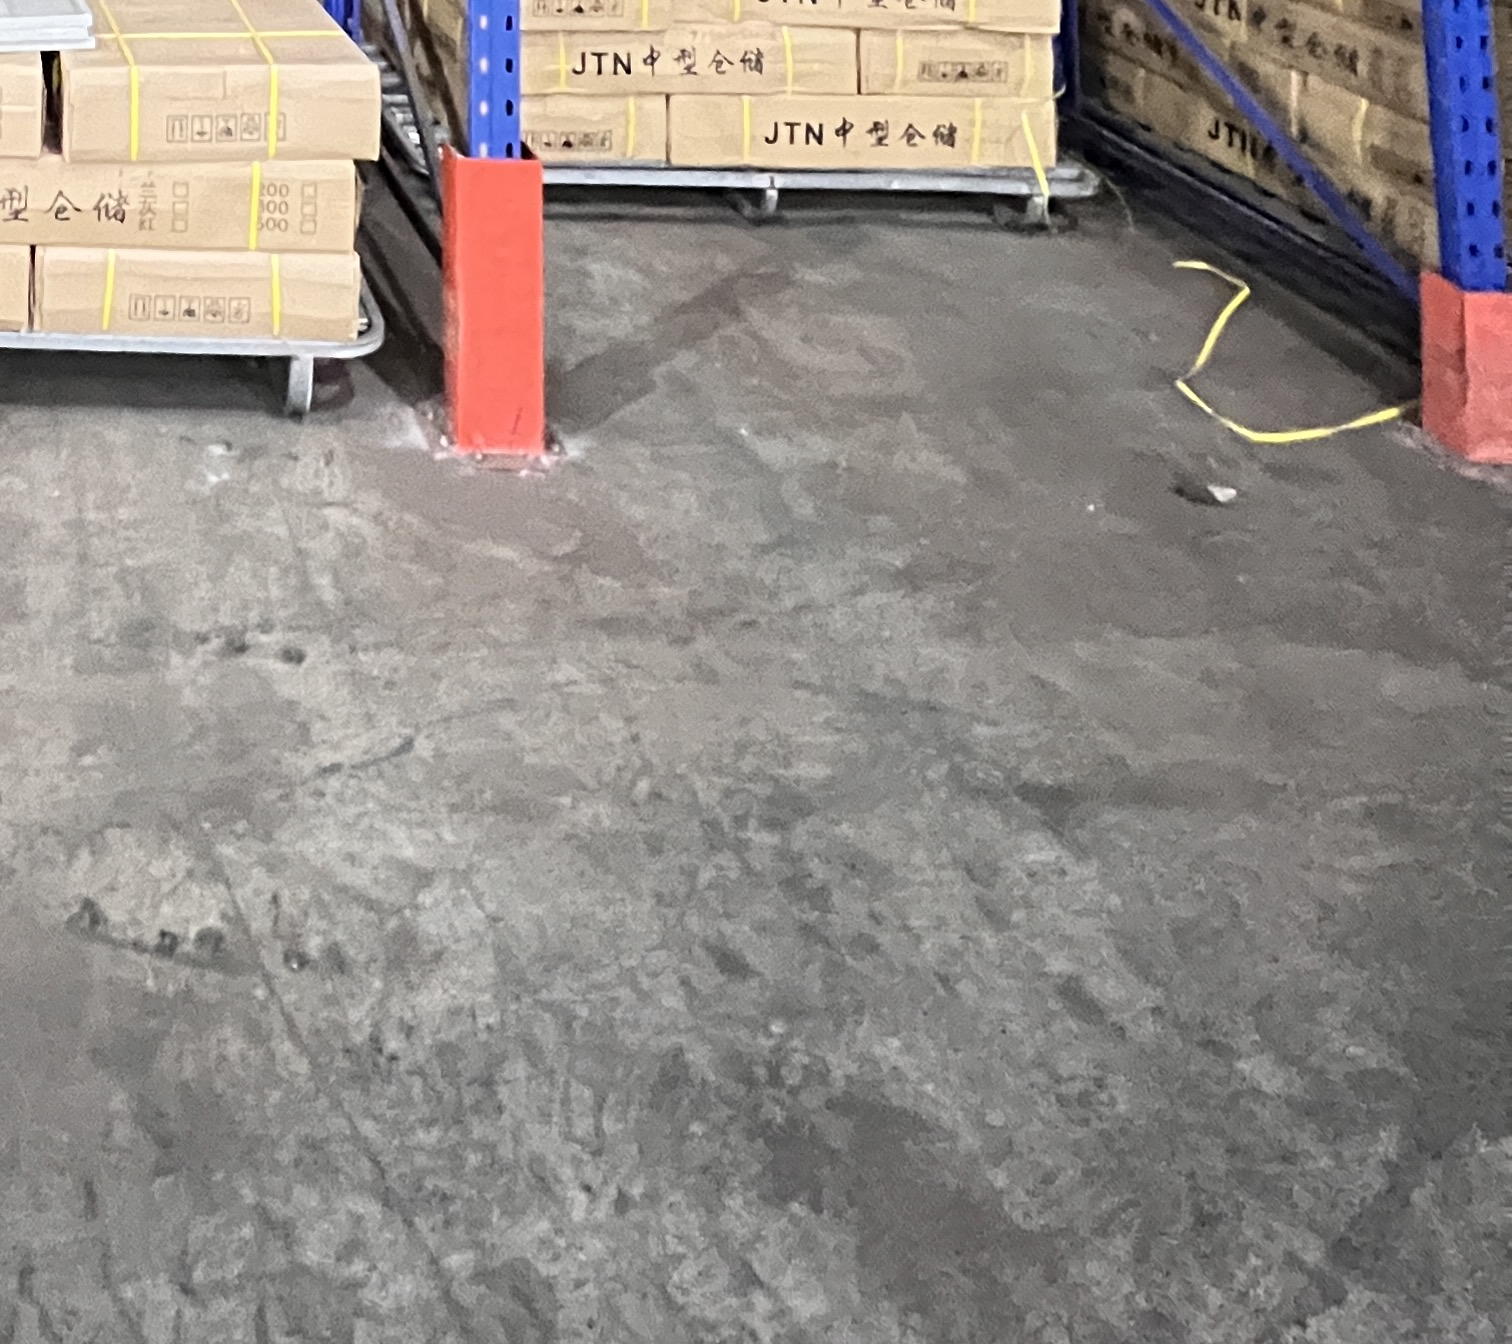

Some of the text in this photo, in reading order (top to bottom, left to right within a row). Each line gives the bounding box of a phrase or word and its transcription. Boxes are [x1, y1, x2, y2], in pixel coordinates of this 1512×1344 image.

[572, 45, 764, 77] JTN 中型仓储
[765, 118, 957, 148] JTN 中型仓储
